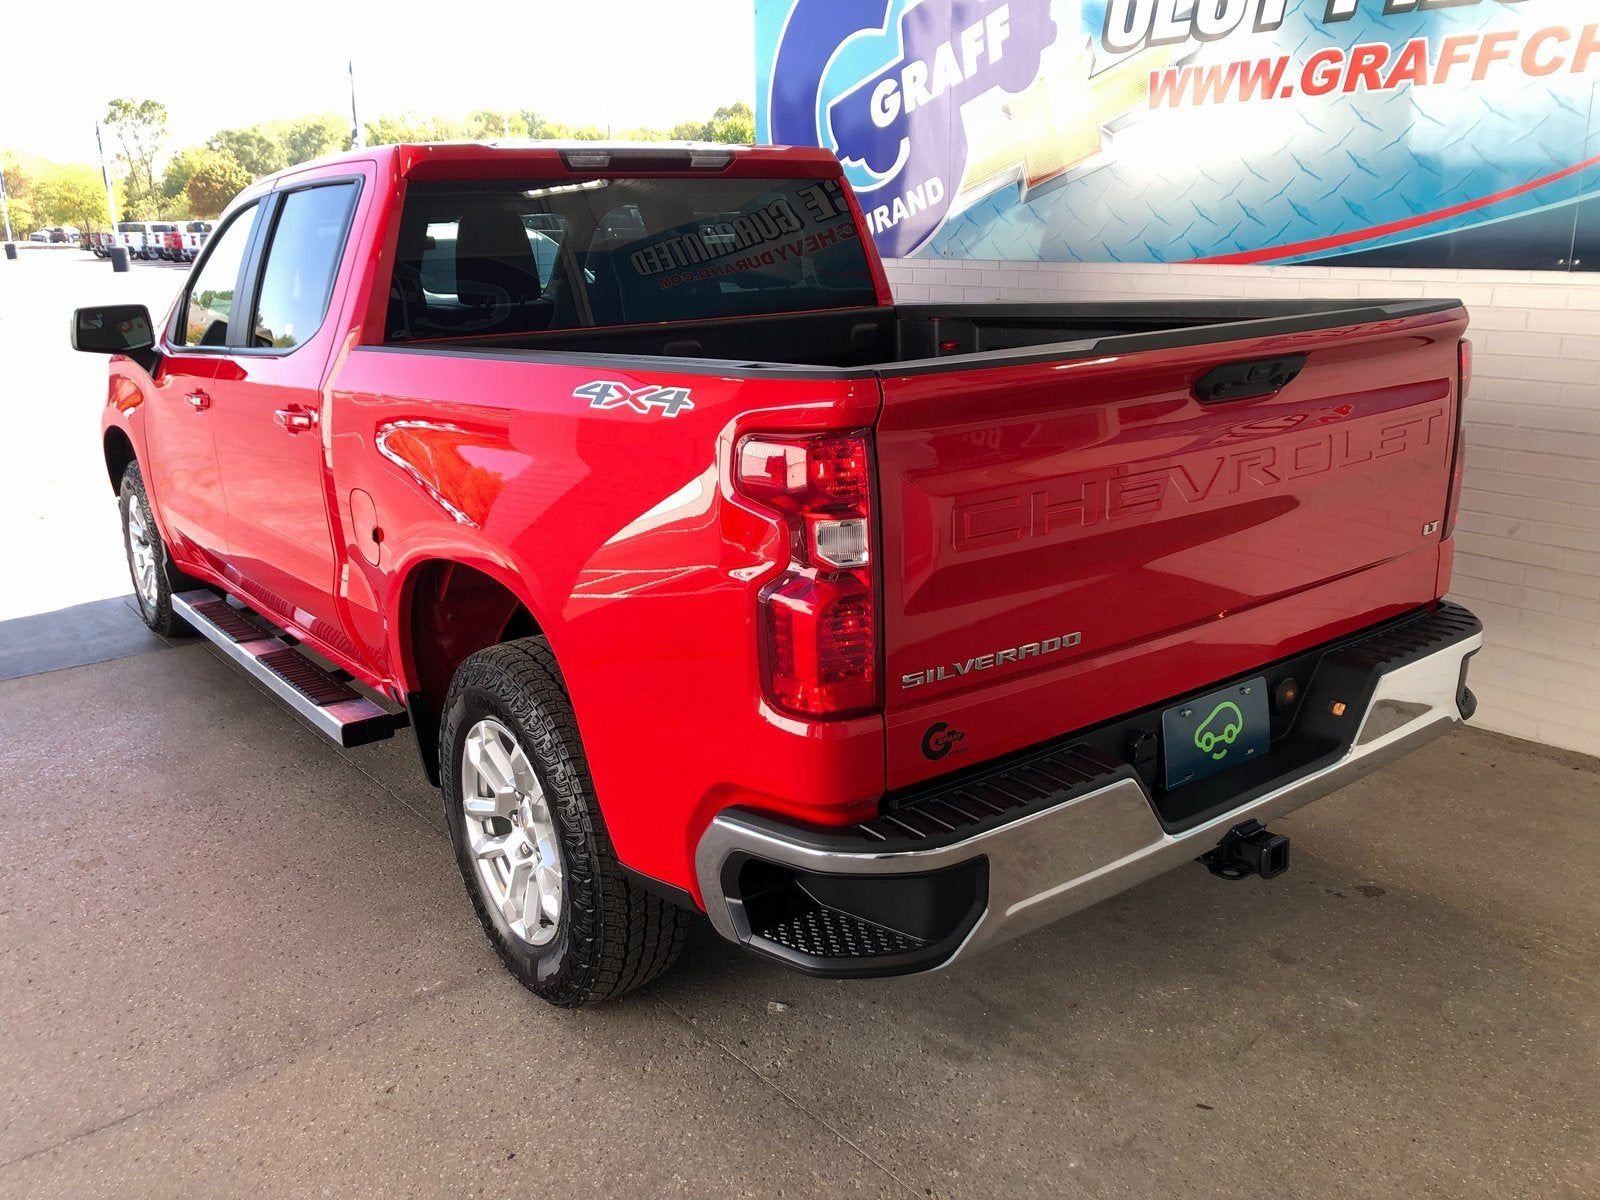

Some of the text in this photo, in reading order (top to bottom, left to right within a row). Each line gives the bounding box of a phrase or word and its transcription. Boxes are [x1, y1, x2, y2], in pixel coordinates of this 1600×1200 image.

[869, 8, 1012, 128] GRAFF
[952, 407, 1443, 552] CHEVROLET
[1422, 520, 1441, 536] LT
[902, 631, 1082, 689] SILVERADO
